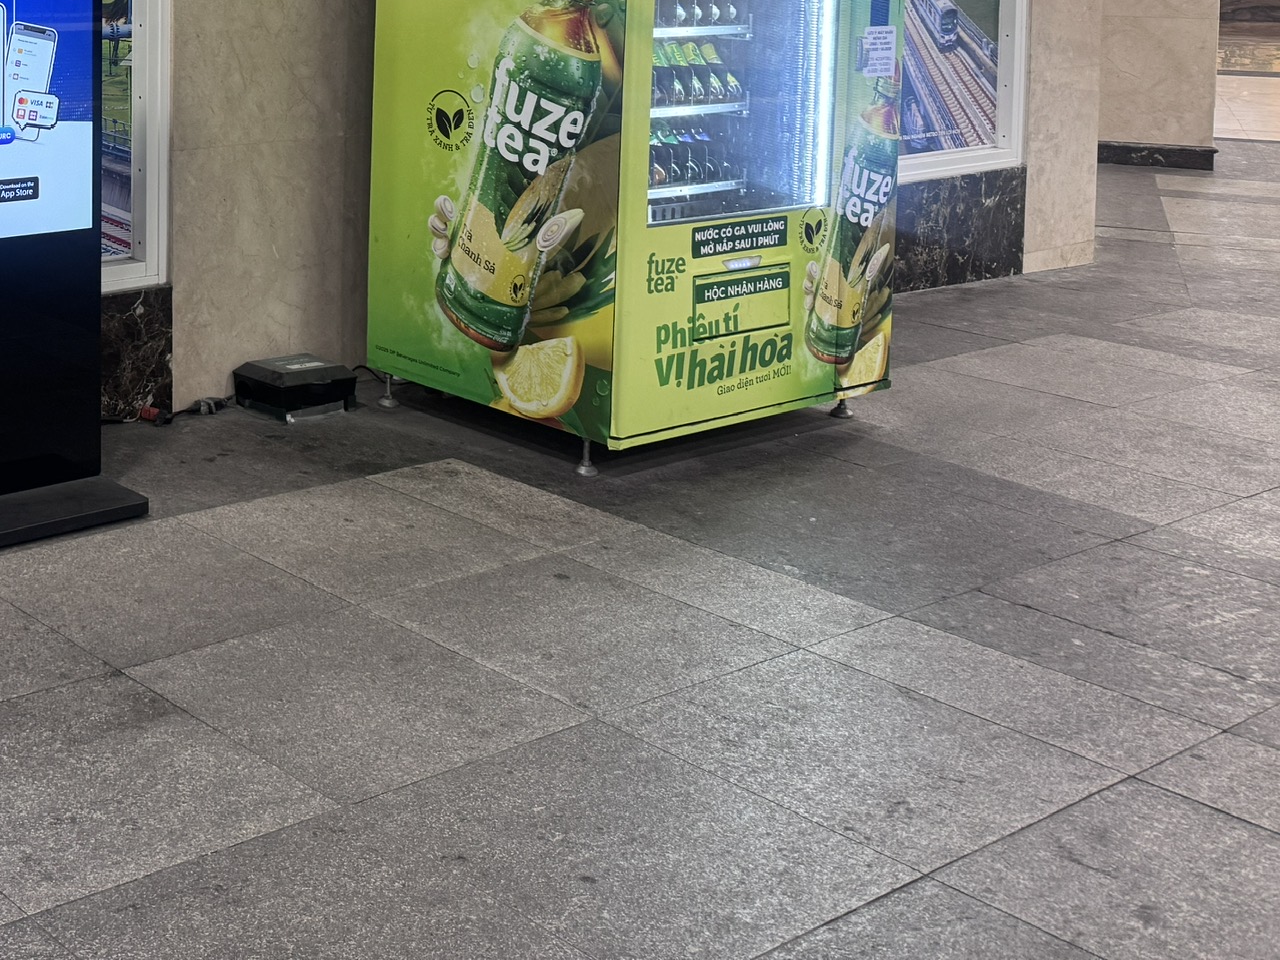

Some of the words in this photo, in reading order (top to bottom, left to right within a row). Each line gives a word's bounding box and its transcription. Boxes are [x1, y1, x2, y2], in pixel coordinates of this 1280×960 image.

[490, 57, 585, 149] fuze
[483, 106, 549, 176] tea
[841, 146, 892, 204] fuze
[1, 190, 15, 198] App
[16, 189, 33, 197] Store
[836, 186, 872, 228] tea
[695, 227, 719, 242] NƯỚC
[721, 225, 734, 237] CÓ
[735, 226, 746, 235] GA
[748, 224, 762, 234] VUI
[763, 220, 785, 232] LÒNG
[647, 252, 686, 276] fuze
[647, 275, 675, 294] tea
[705, 286, 726, 302] HỘC
[727, 280, 755, 296] NHẬN
[756, 277, 783, 290] HÀNG
[687, 341, 736, 390] hài
[738, 332, 793, 374] hòa
[717, 385, 735, 396] Giao
[737, 377, 754, 390] diện
